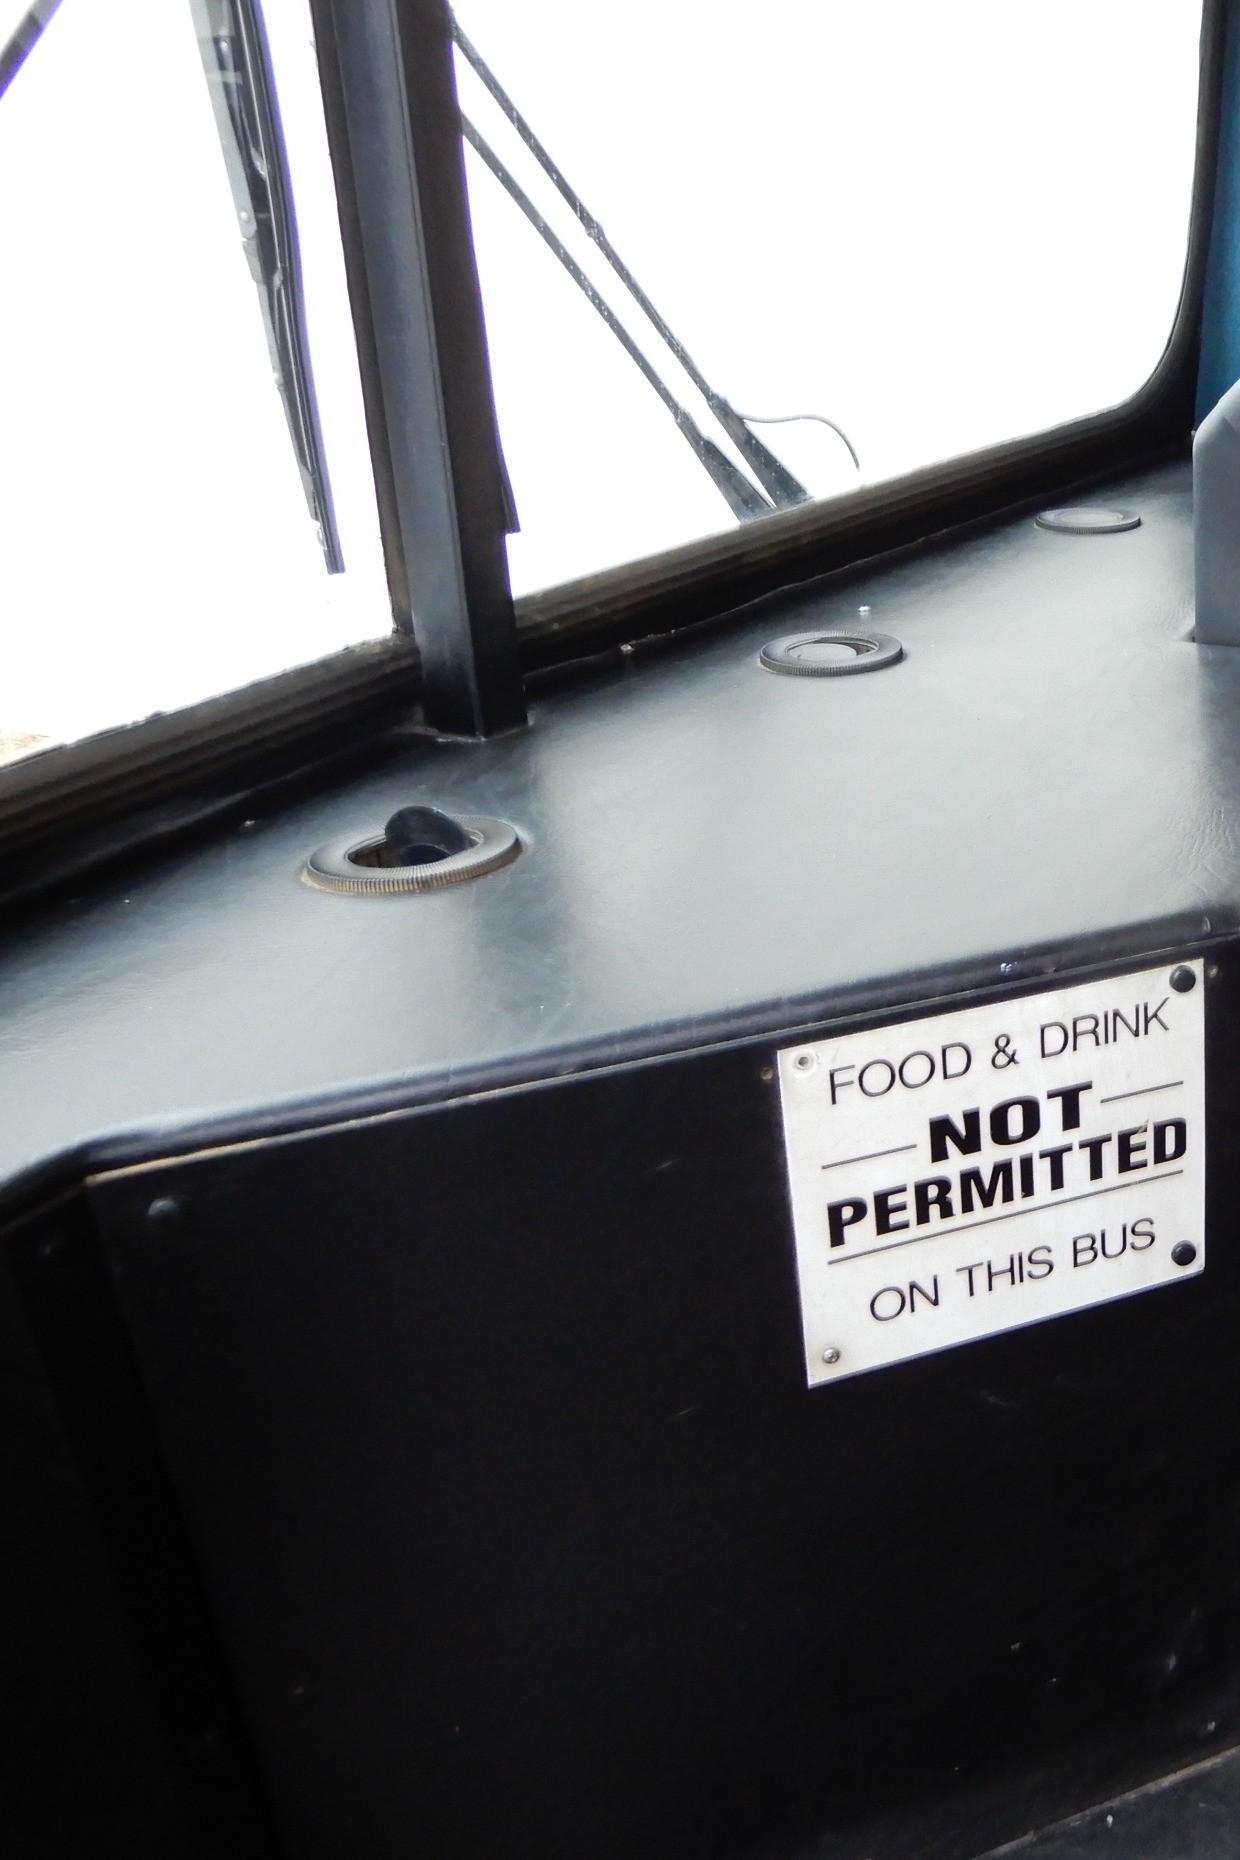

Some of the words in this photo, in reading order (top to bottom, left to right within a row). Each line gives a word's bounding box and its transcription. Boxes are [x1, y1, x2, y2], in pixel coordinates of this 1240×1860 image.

[829, 1042, 972, 1106] FOOD
[990, 1033, 1020, 1070] &
[1040, 997, 1170, 1059] DRINK
[928, 1080, 1093, 1164] NOT
[826, 1117, 1188, 1249] PERMITTED
[869, 1274, 940, 1322] ON
[955, 1245, 1055, 1298] THIS
[1072, 1217, 1156, 1269] BUS
